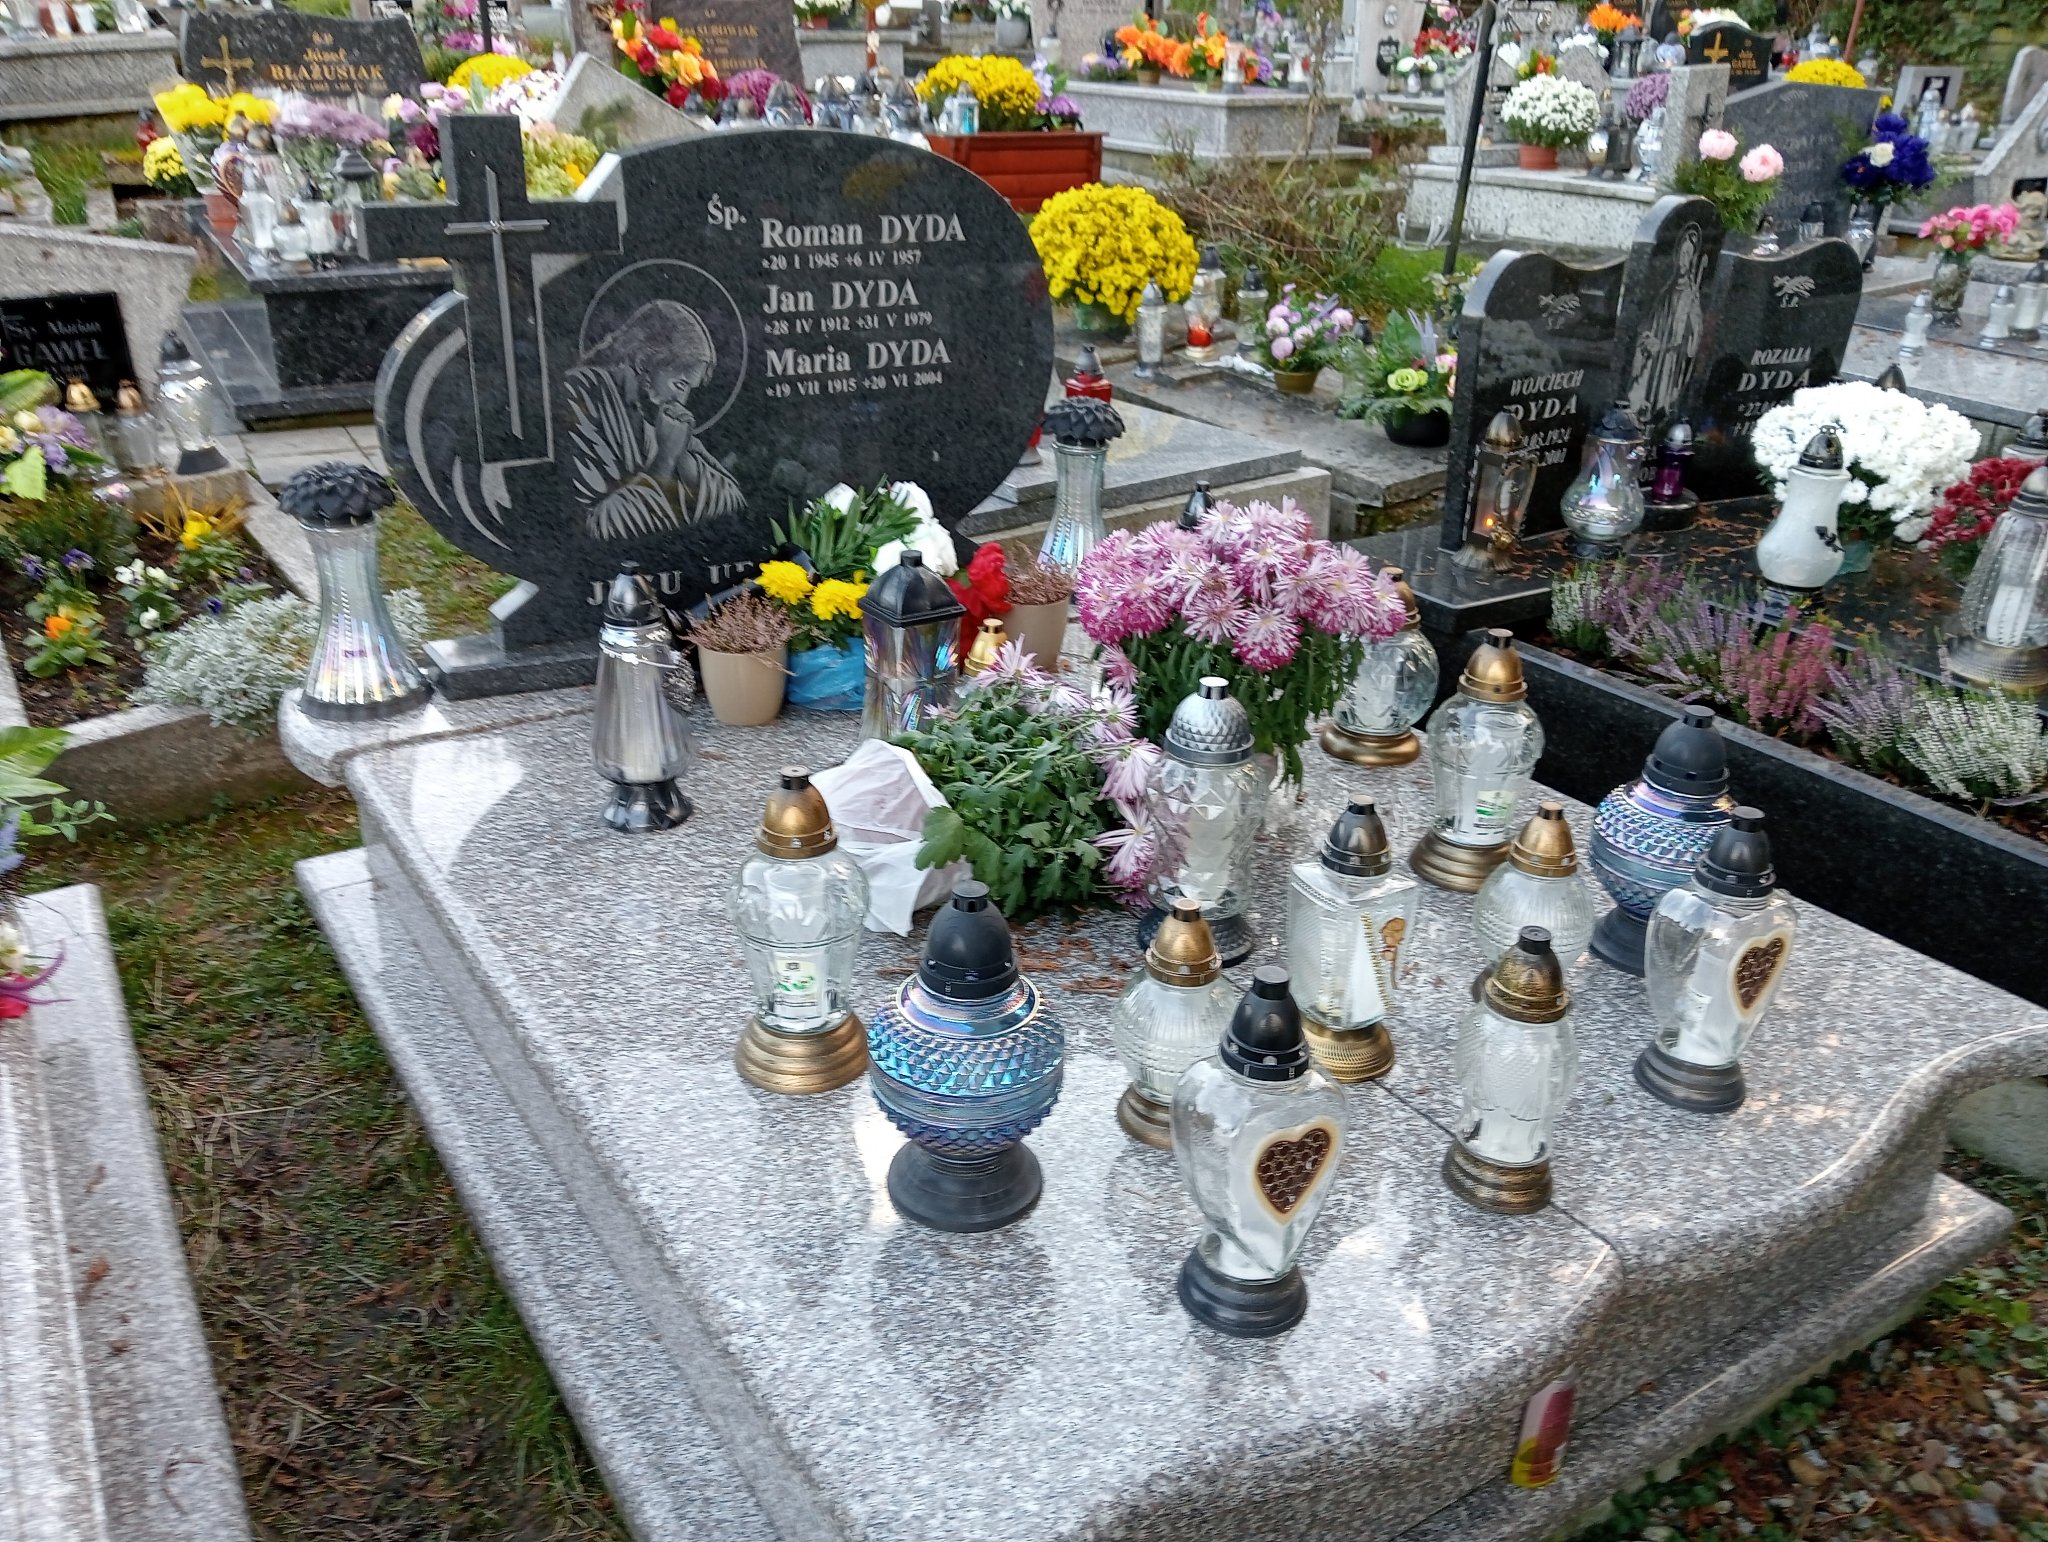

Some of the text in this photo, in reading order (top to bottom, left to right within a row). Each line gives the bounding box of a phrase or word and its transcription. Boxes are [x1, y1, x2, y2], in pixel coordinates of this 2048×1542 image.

[760, 212, 966, 248] Roman DYDA
[808, 252, 839, 269] 1945
[869, 250, 886, 266] IV
[892, 249, 922, 266] 1957
[762, 277, 920, 314] Jan DYDA
[796, 317, 813, 333] IV
[820, 315, 850, 332] 1912
[886, 312, 898, 328] V
[904, 310, 933, 327] 1979
[765, 337, 952, 378] Maria DYDA
[797, 380, 820, 396] VII
[827, 377, 857, 394] 1915
[892, 373, 908, 388] VI
[1510, 368, 1584, 396] WOJCIECH
[1737, 368, 1812, 392] DYDA
[1503, 393, 1577, 421] DYDA
